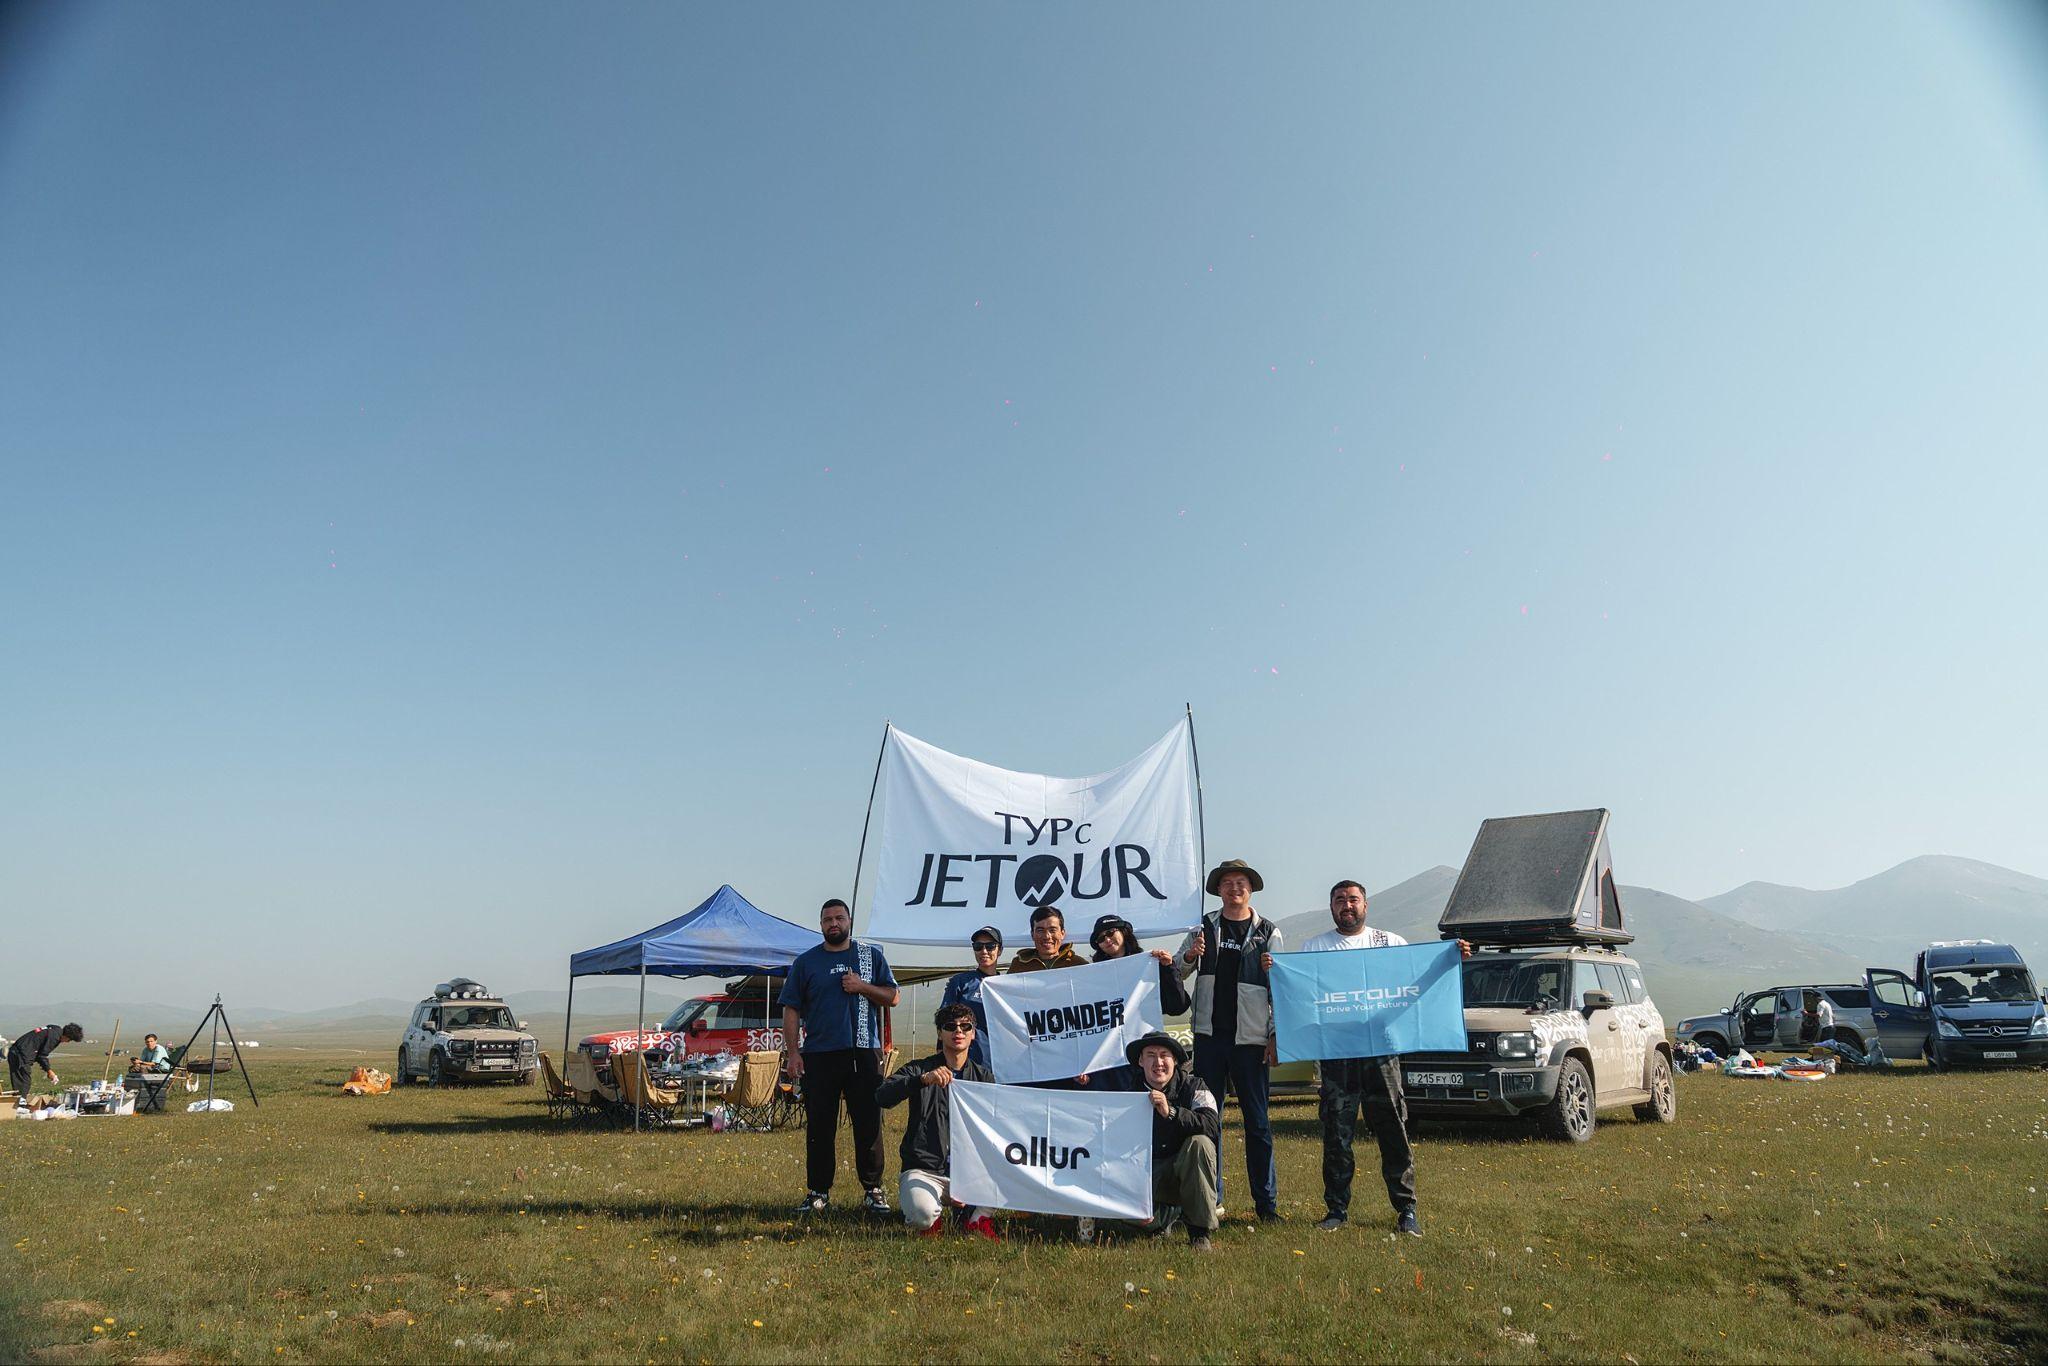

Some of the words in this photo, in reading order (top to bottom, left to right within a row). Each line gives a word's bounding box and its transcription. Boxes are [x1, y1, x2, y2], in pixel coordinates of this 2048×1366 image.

[904, 843, 1168, 908] JETOUR
[1221, 942, 1240, 951] ETOUR
[1313, 985, 1420, 1005] JETOUR
[1326, 1005, 1351, 1014] Drive
[1352, 1003, 1376, 1011] Your
[1377, 1001, 1408, 1009] Future
[1024, 1000, 1125, 1035] WONDER
[1060, 1025, 1110, 1040] JETOUR
[1417, 1074, 1434, 1083] 215
[1450, 1074, 1463, 1084] 02
[1004, 1136, 1091, 1170] allur
